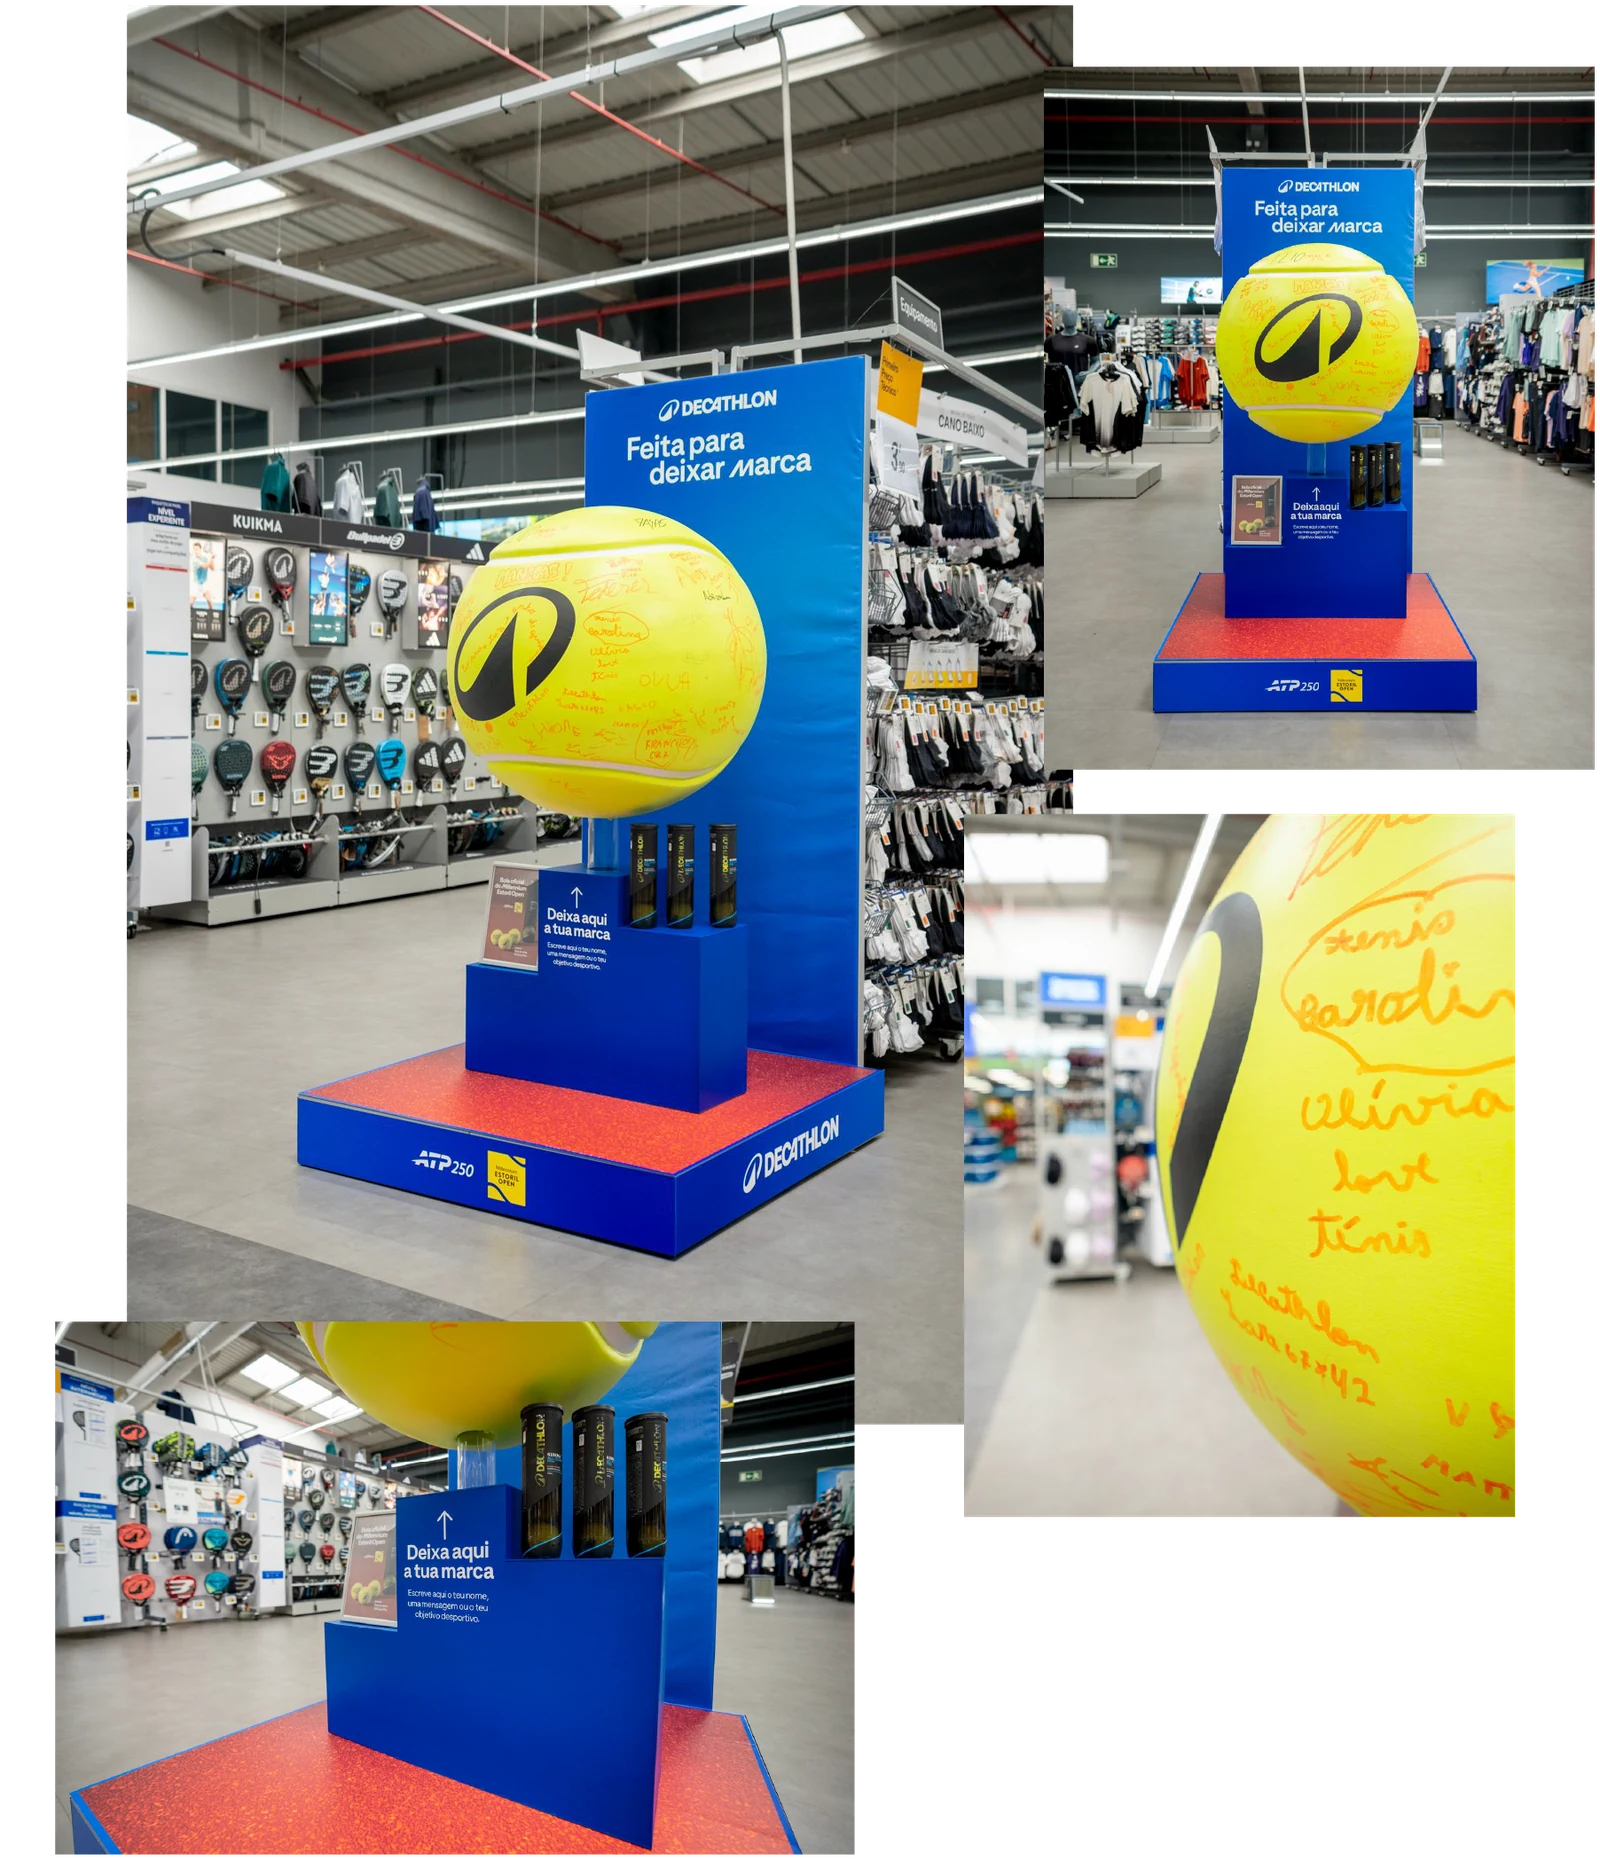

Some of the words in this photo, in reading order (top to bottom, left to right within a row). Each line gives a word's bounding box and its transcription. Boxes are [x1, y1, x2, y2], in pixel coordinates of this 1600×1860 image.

[1295, 182, 1360, 192] DECATHLON
[1255, 200, 1298, 216] Feita
[1300, 204, 1339, 219] para
[1271, 217, 1325, 233] deixar
[900, 296, 938, 333] Equipamento
[682, 389, 777, 417] DECATHLON
[938, 414, 962, 432] CANO
[963, 420, 985, 438] BAIXO
[627, 434, 685, 461] Feita
[689, 431, 745, 461] para
[650, 458, 725, 485] deixar
[157, 507, 175, 517] NÍVEL
[1293, 502, 1319, 511] Deixa
[1319, 502, 1340, 512] aqui
[148, 513, 185, 526] EXPERIENTE
[233, 514, 283, 533] KUIKMA
[1298, 512, 1313, 520] tua
[347, 530, 390, 545] Bullpadel
[1265, 680, 1300, 691] ATP
[1300, 682, 1320, 691] 250
[547, 907, 580, 923] Deixa
[581, 913, 608, 928] aqui
[544, 924, 551, 934] a
[552, 923, 572, 936] tua
[573, 927, 611, 941] marca
[547, 942, 566, 950] Escreve
[765, 1115, 839, 1178] DECATHLON
[411, 1150, 452, 1171] ATP
[451, 1161, 474, 1178] 250
[494, 1170, 519, 1182] ESTORIL
[498, 1178, 515, 1187] OPEN
[407, 1543, 450, 1560] Deixa
[452, 1540, 489, 1563] aqui
[403, 1566, 412, 1579] a
[414, 1564, 439, 1579] tua
[441, 1566, 495, 1580] marca
[407, 1589, 431, 1597] Escreve
[432, 1590, 446, 1599] aqui
[453, 1591, 465, 1599] teu
[465, 1593, 489, 1602] nome,
[421, 1601, 458, 1611] mensagem
[459, 1603, 468, 1611] ou
[475, 1603, 489, 1612] teu
[415, 1610, 440, 1620] objetivo
[441, 1612, 480, 1623] desportivo.
